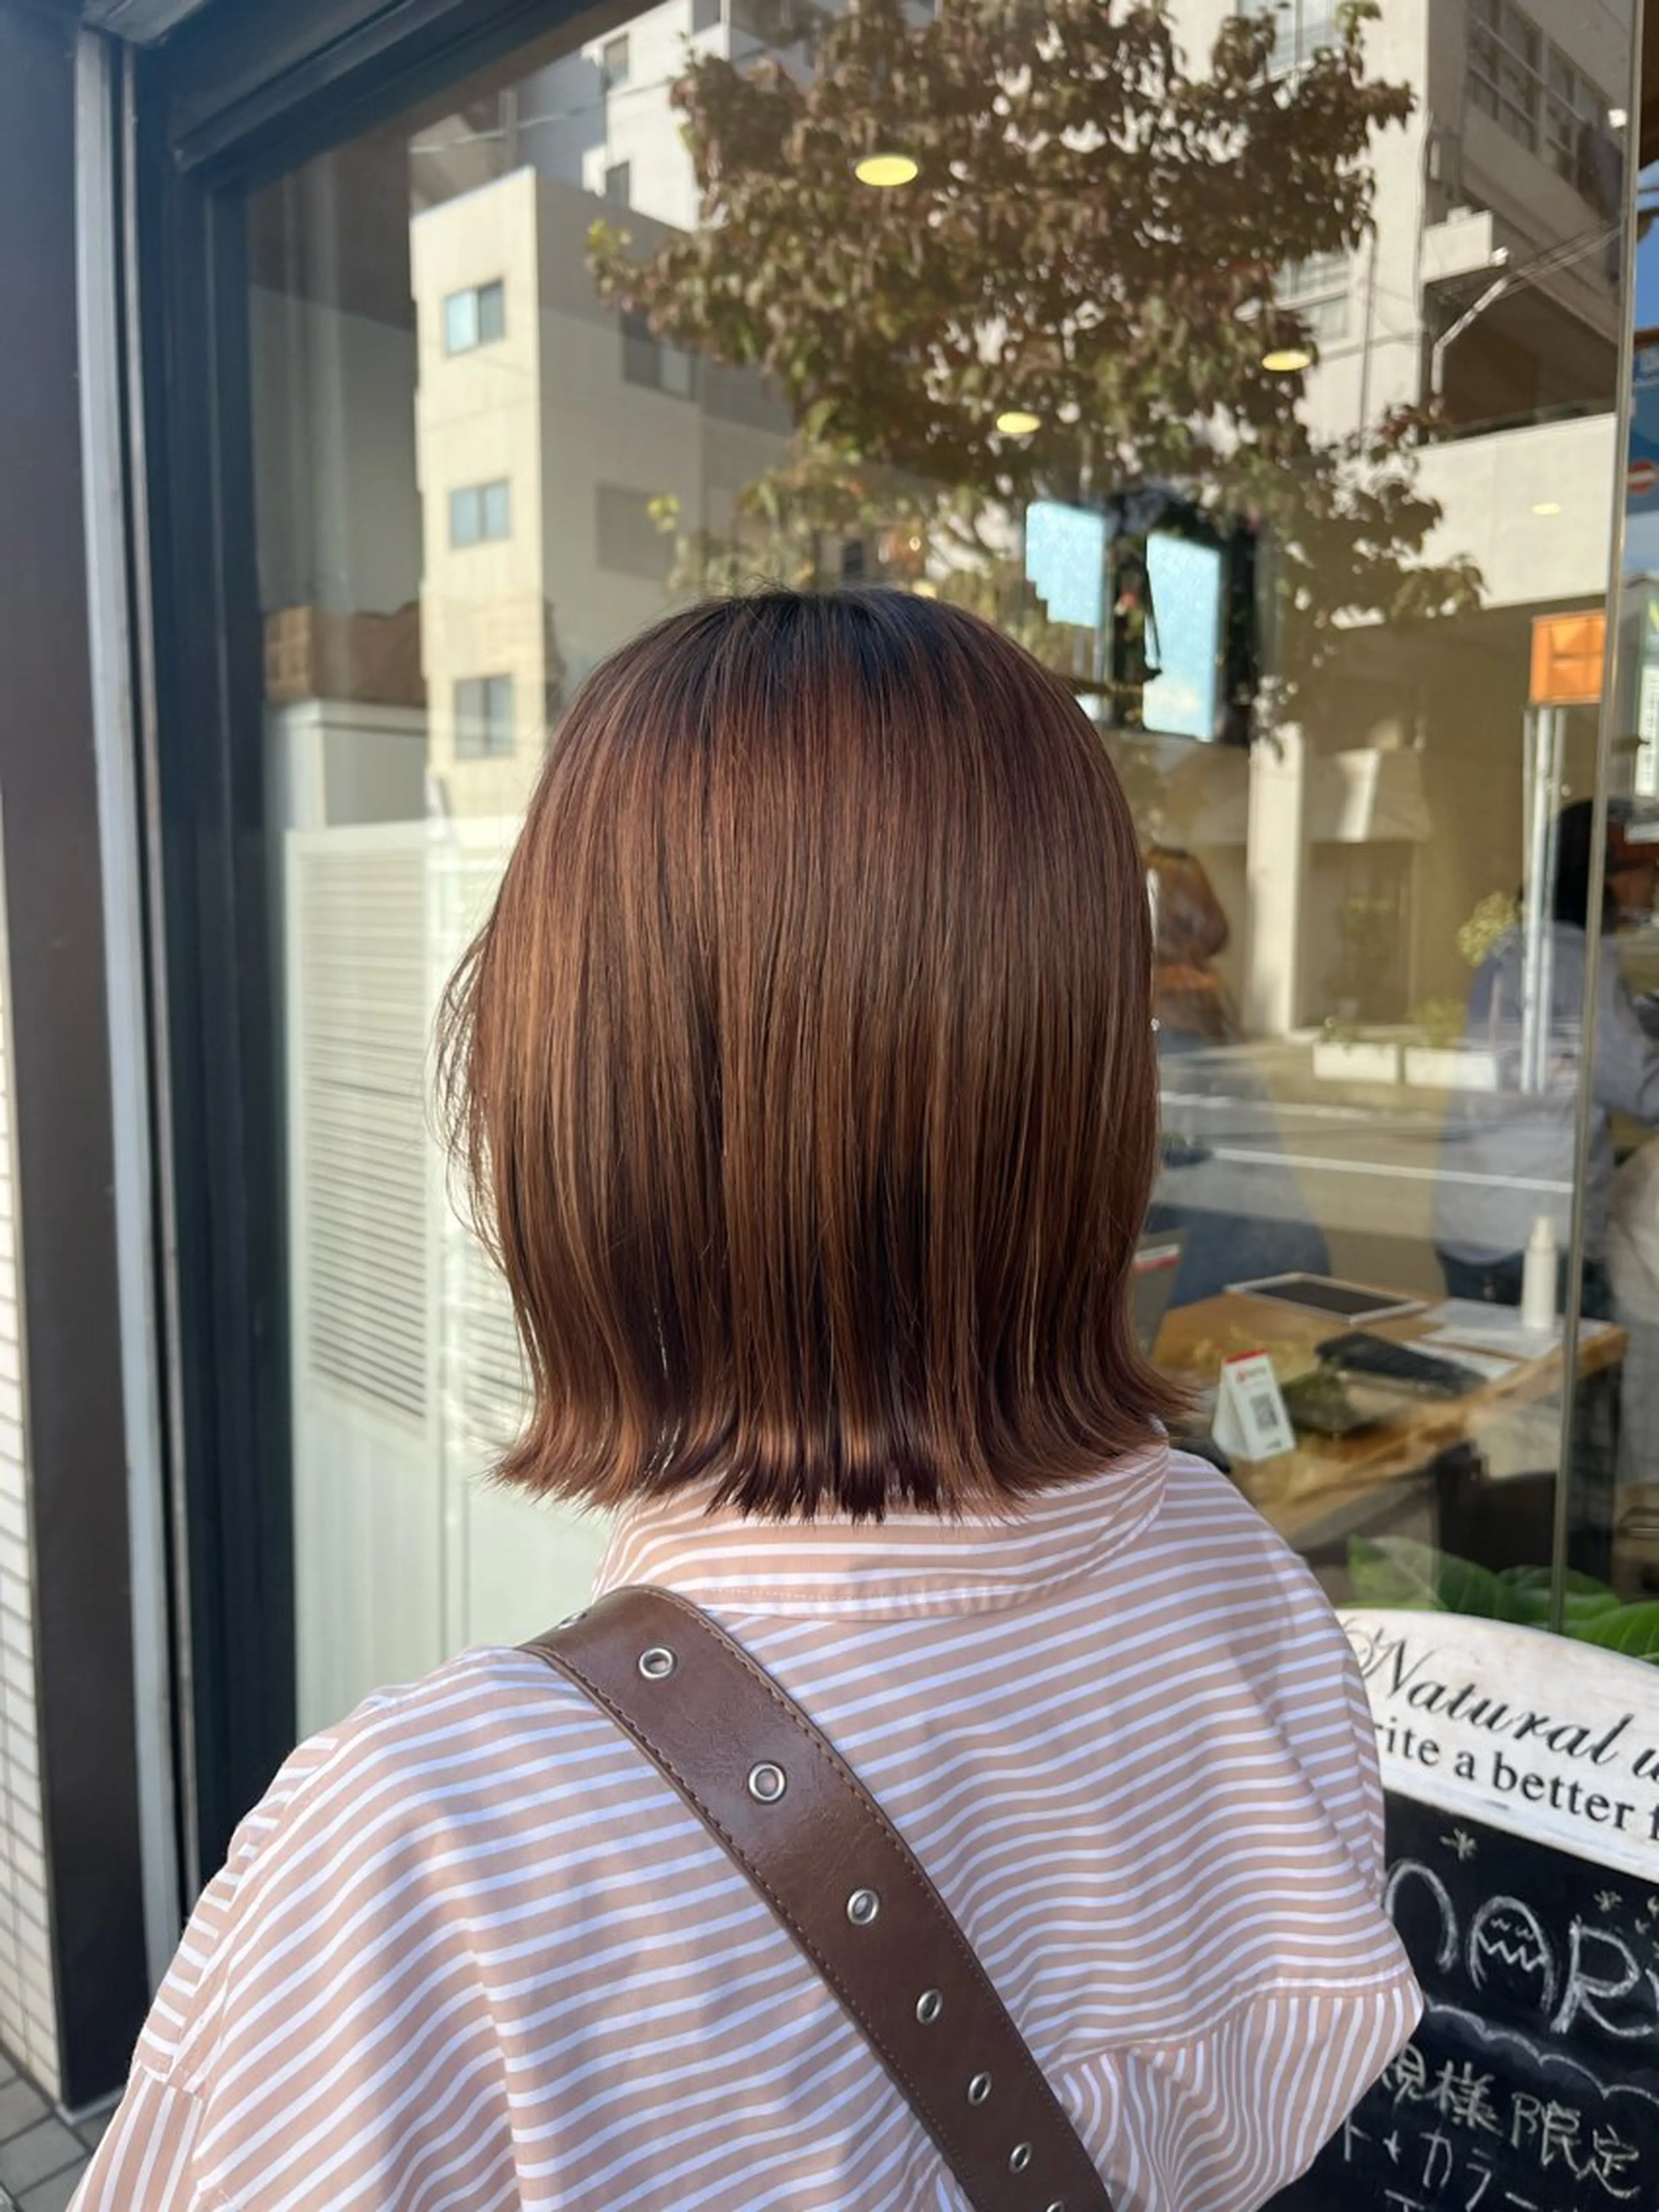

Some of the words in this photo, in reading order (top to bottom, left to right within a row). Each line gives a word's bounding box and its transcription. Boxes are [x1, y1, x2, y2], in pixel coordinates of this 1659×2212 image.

[1342, 1618, 1634, 1765] Natural
[1374, 1716, 1440, 1767] ite
[1454, 1751, 1476, 1781] a
[1493, 1751, 1635, 1831] better
